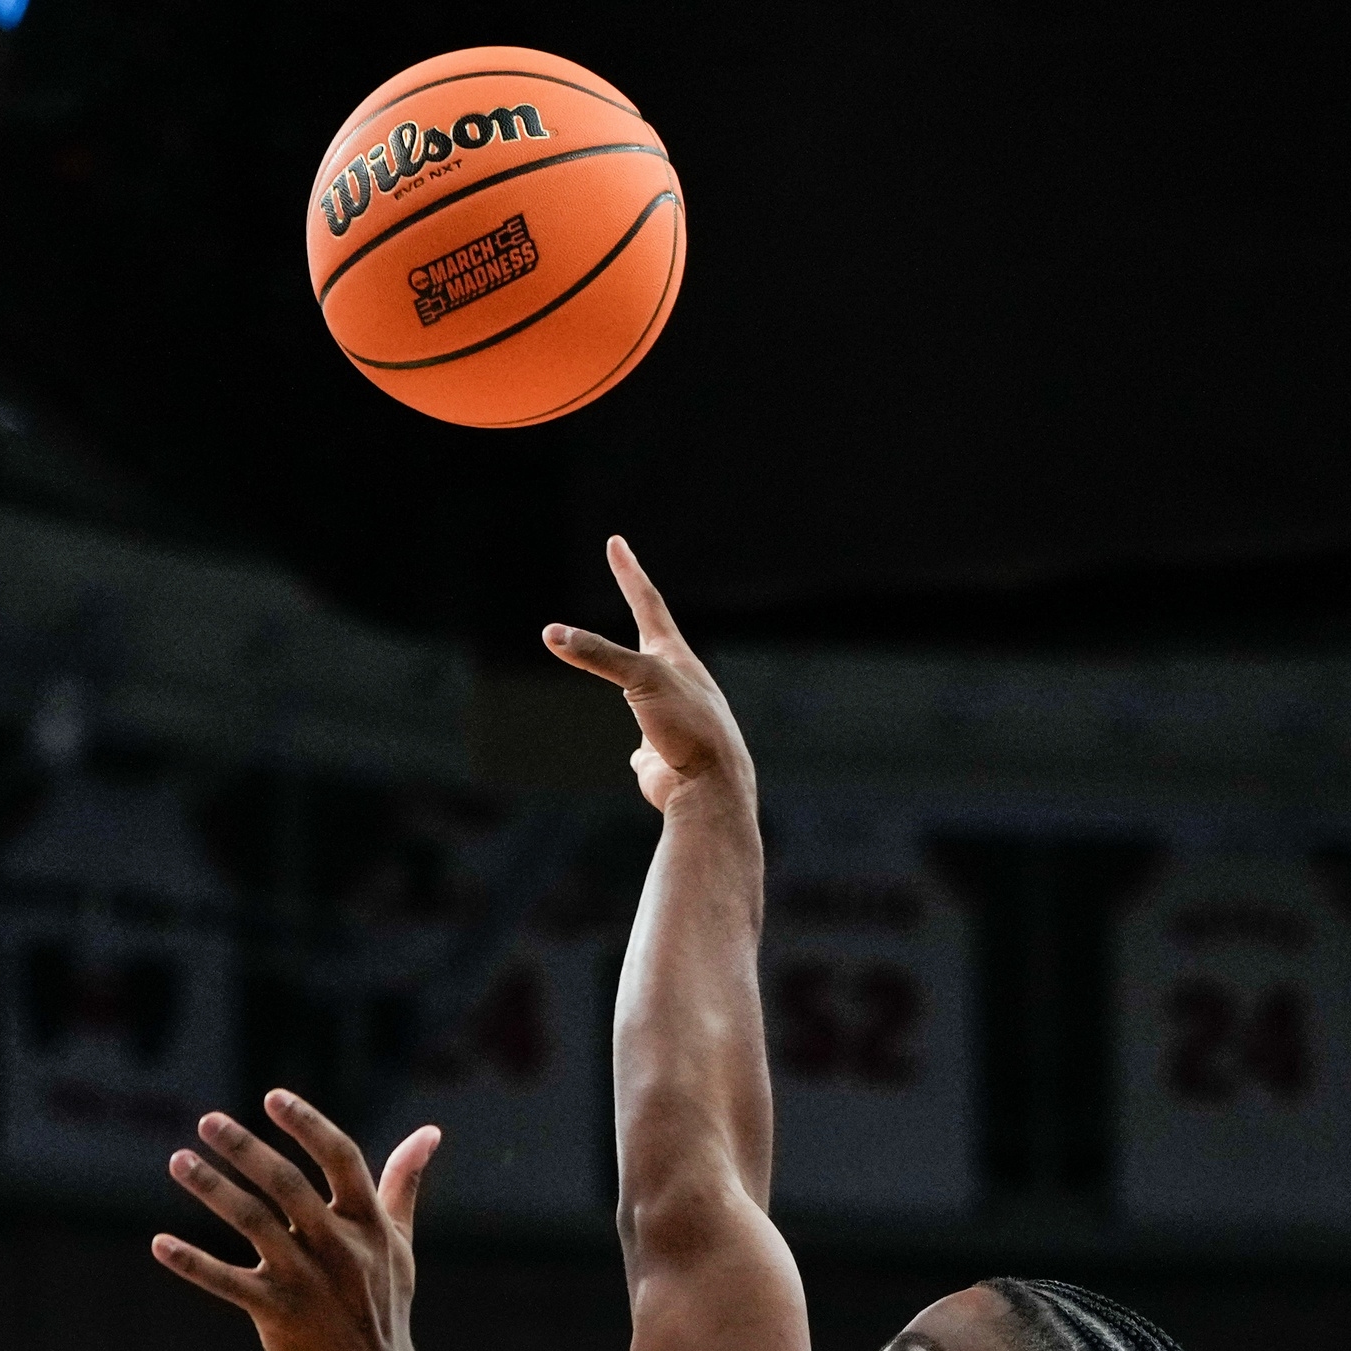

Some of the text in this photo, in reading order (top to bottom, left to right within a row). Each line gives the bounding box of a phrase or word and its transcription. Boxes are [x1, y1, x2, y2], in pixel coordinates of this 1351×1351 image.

[320, 102, 550, 238] Wilson
[393, 158, 463, 201] EVO NXT
[428, 236, 496, 285] MARCH
[445, 241, 537, 301] MADNESS
[1163, 975, 1311, 1106] 24
